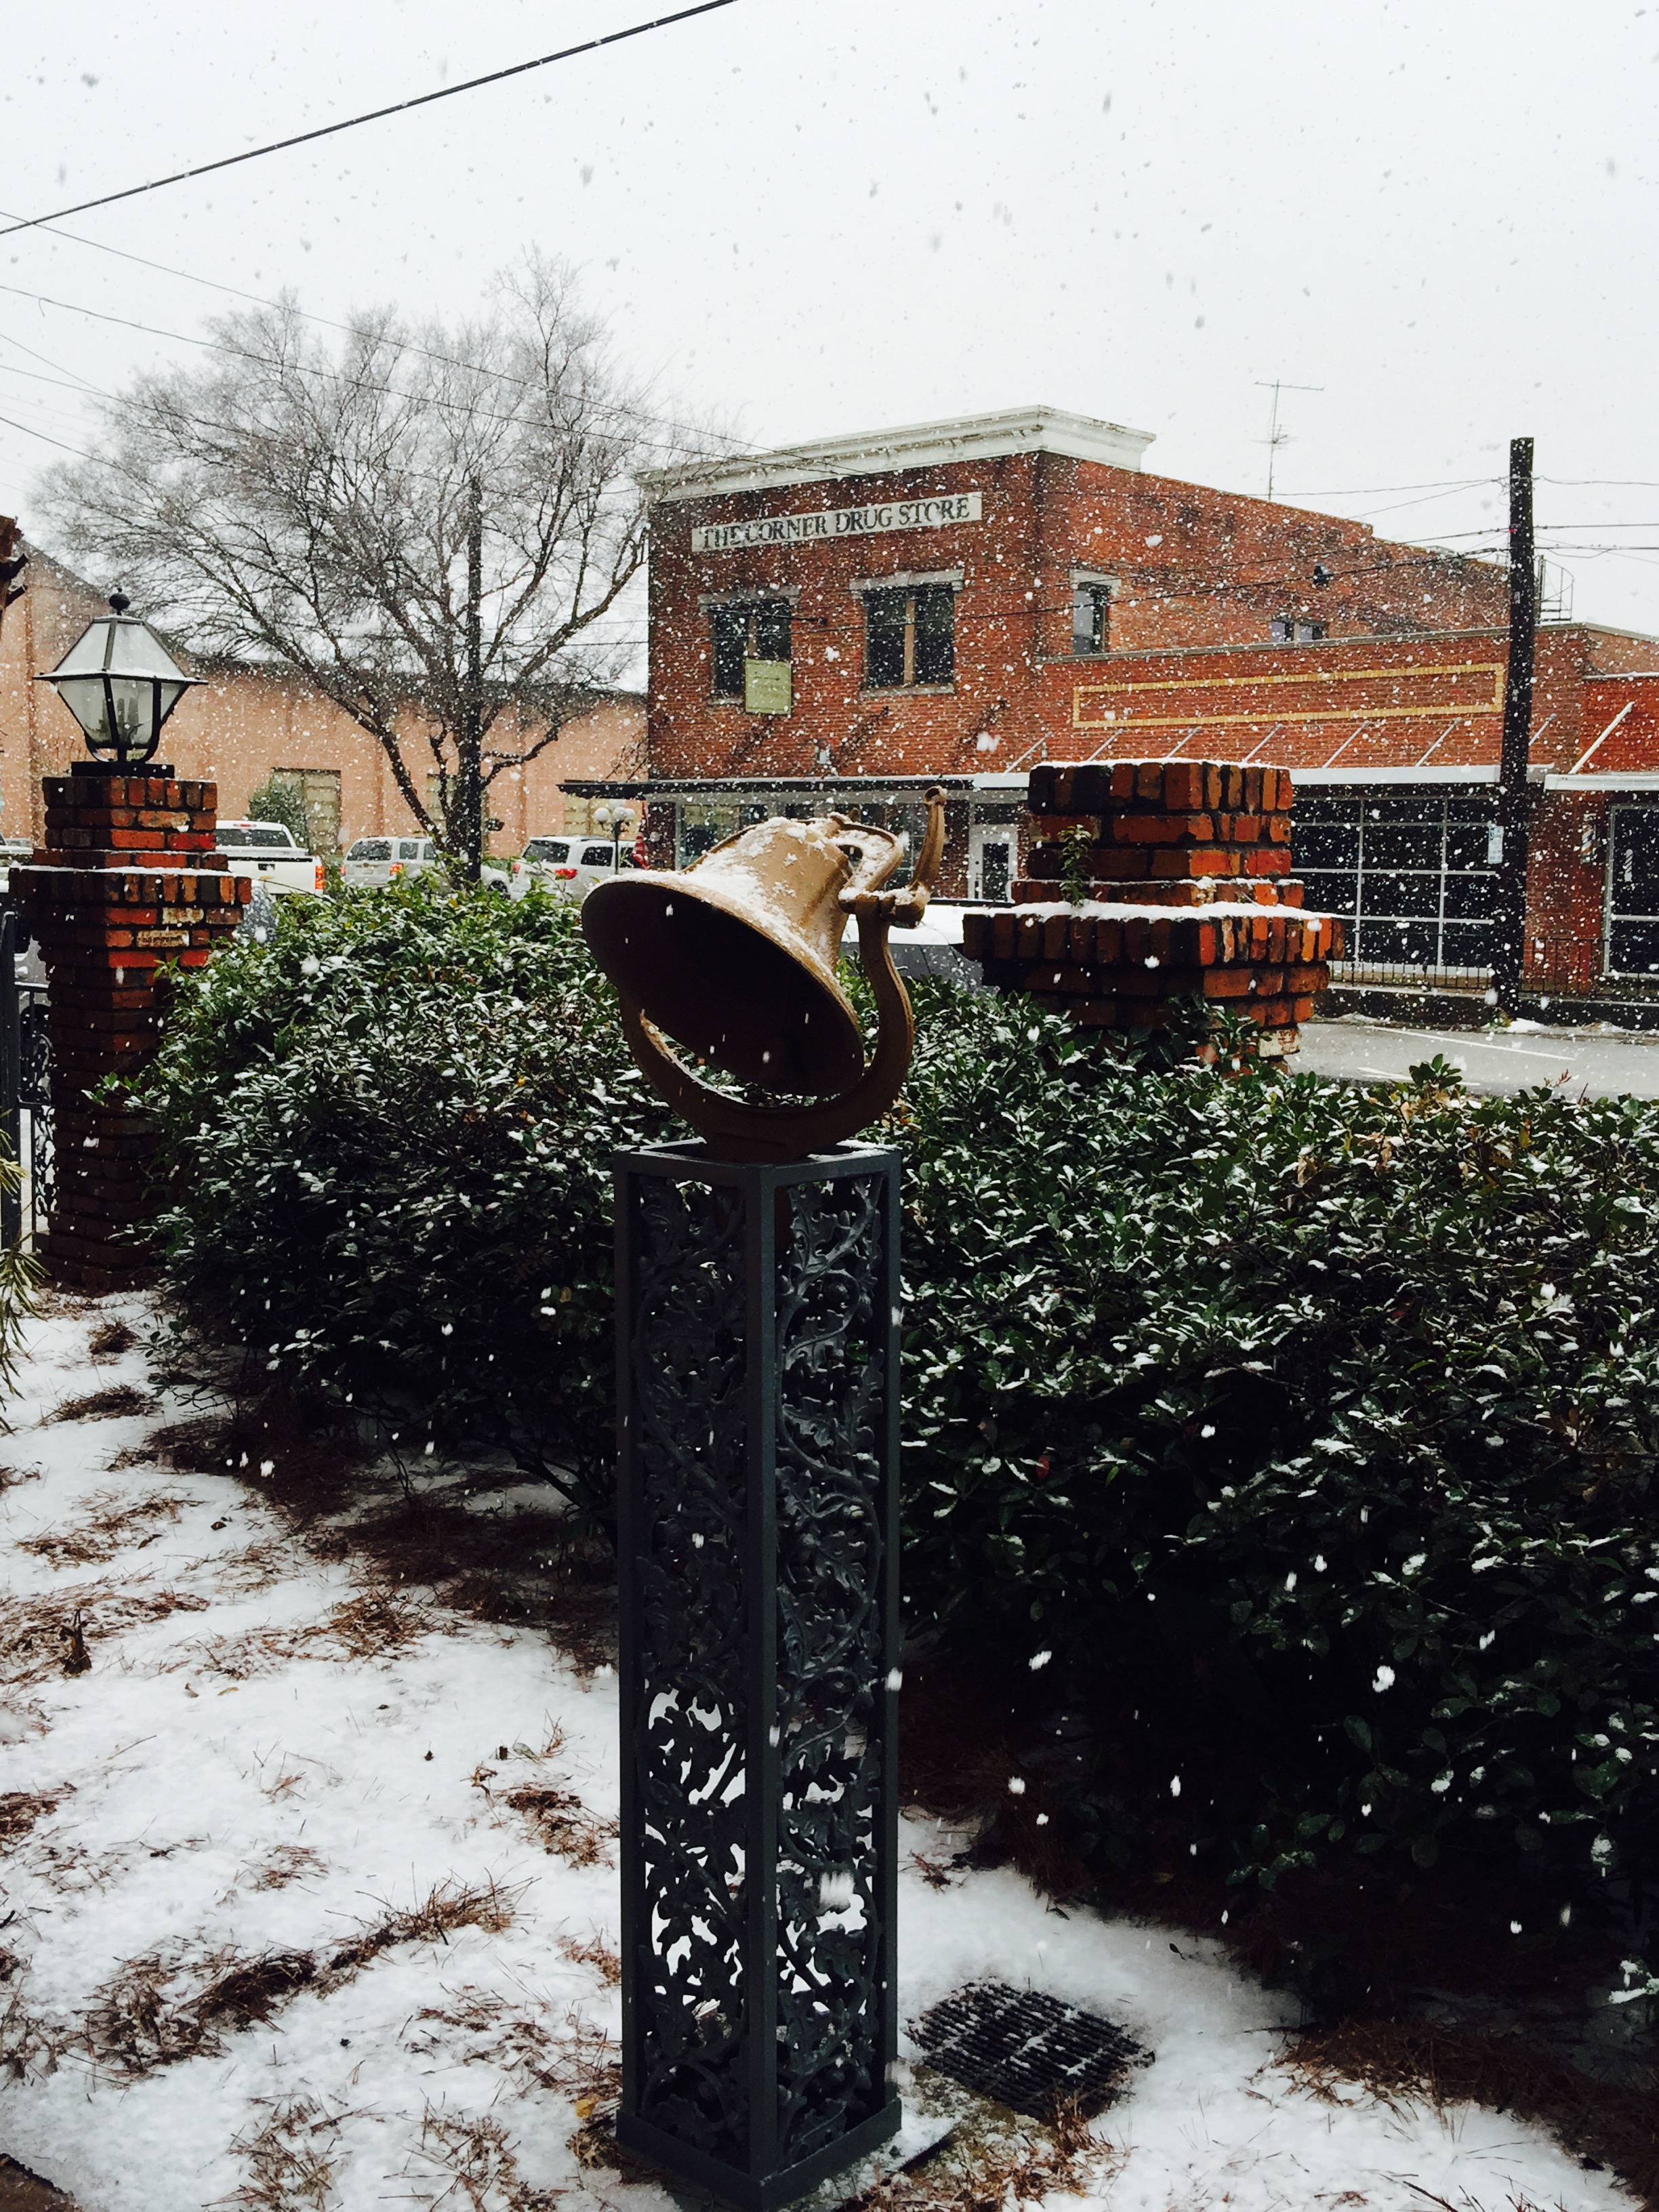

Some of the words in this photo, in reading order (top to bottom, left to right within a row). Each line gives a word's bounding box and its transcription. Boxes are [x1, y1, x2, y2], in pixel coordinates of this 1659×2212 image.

[701, 527, 743, 548] THE
[745, 515, 827, 541] CORNER
[835, 507, 893, 533] DRUG
[899, 497, 970, 525] STORE
